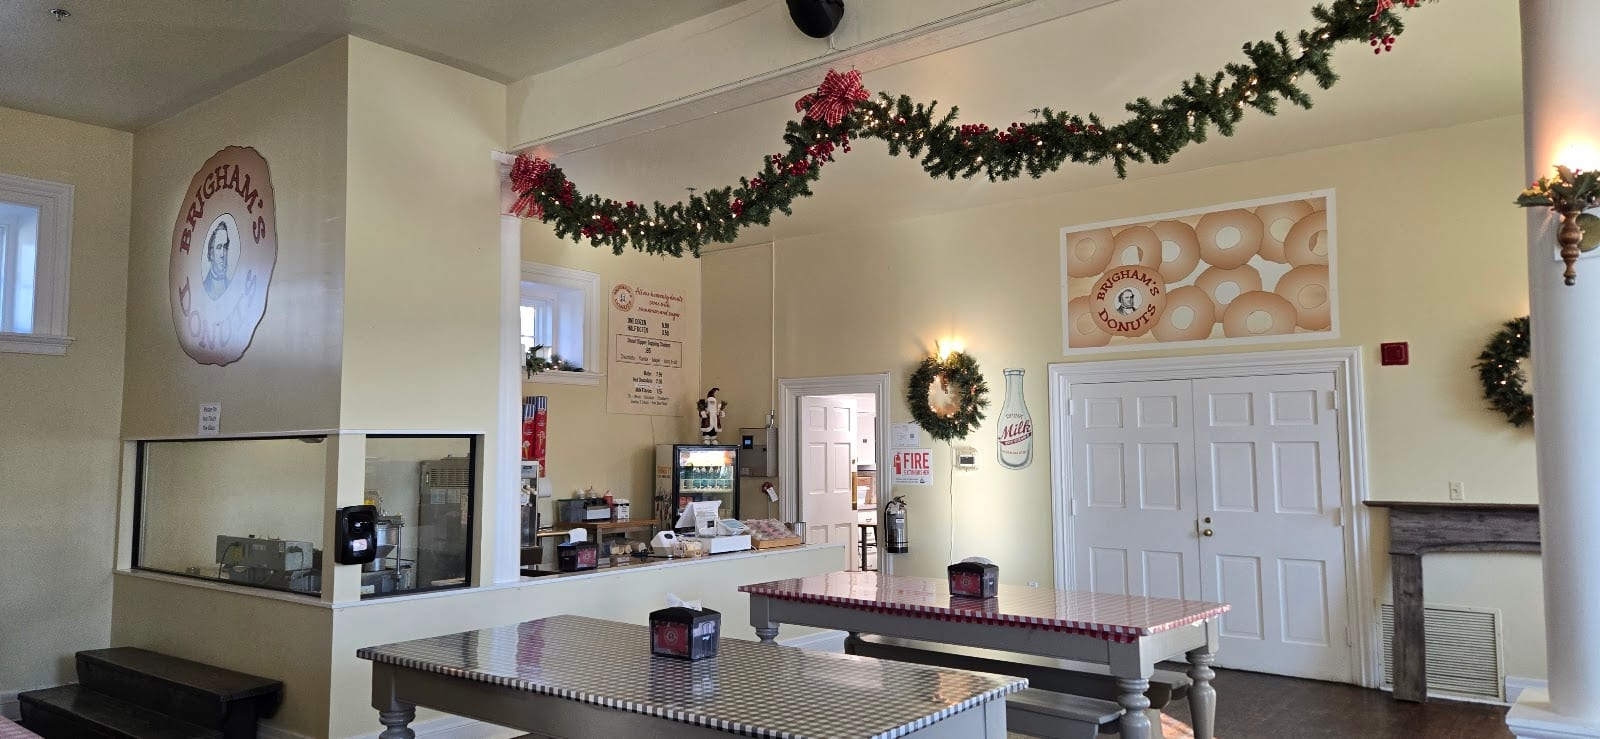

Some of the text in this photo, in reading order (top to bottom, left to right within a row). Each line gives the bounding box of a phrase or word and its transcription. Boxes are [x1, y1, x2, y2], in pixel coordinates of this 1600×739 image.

[179, 164, 266, 256] BRIGHAM'S
[1096, 269, 1160, 302] BRIGHAM'S
[179, 269, 257, 351] DONUTS
[1097, 303, 1157, 332] DONUTS
[998, 419, 1032, 440] Milk
[903, 452, 930, 469] FIRE
